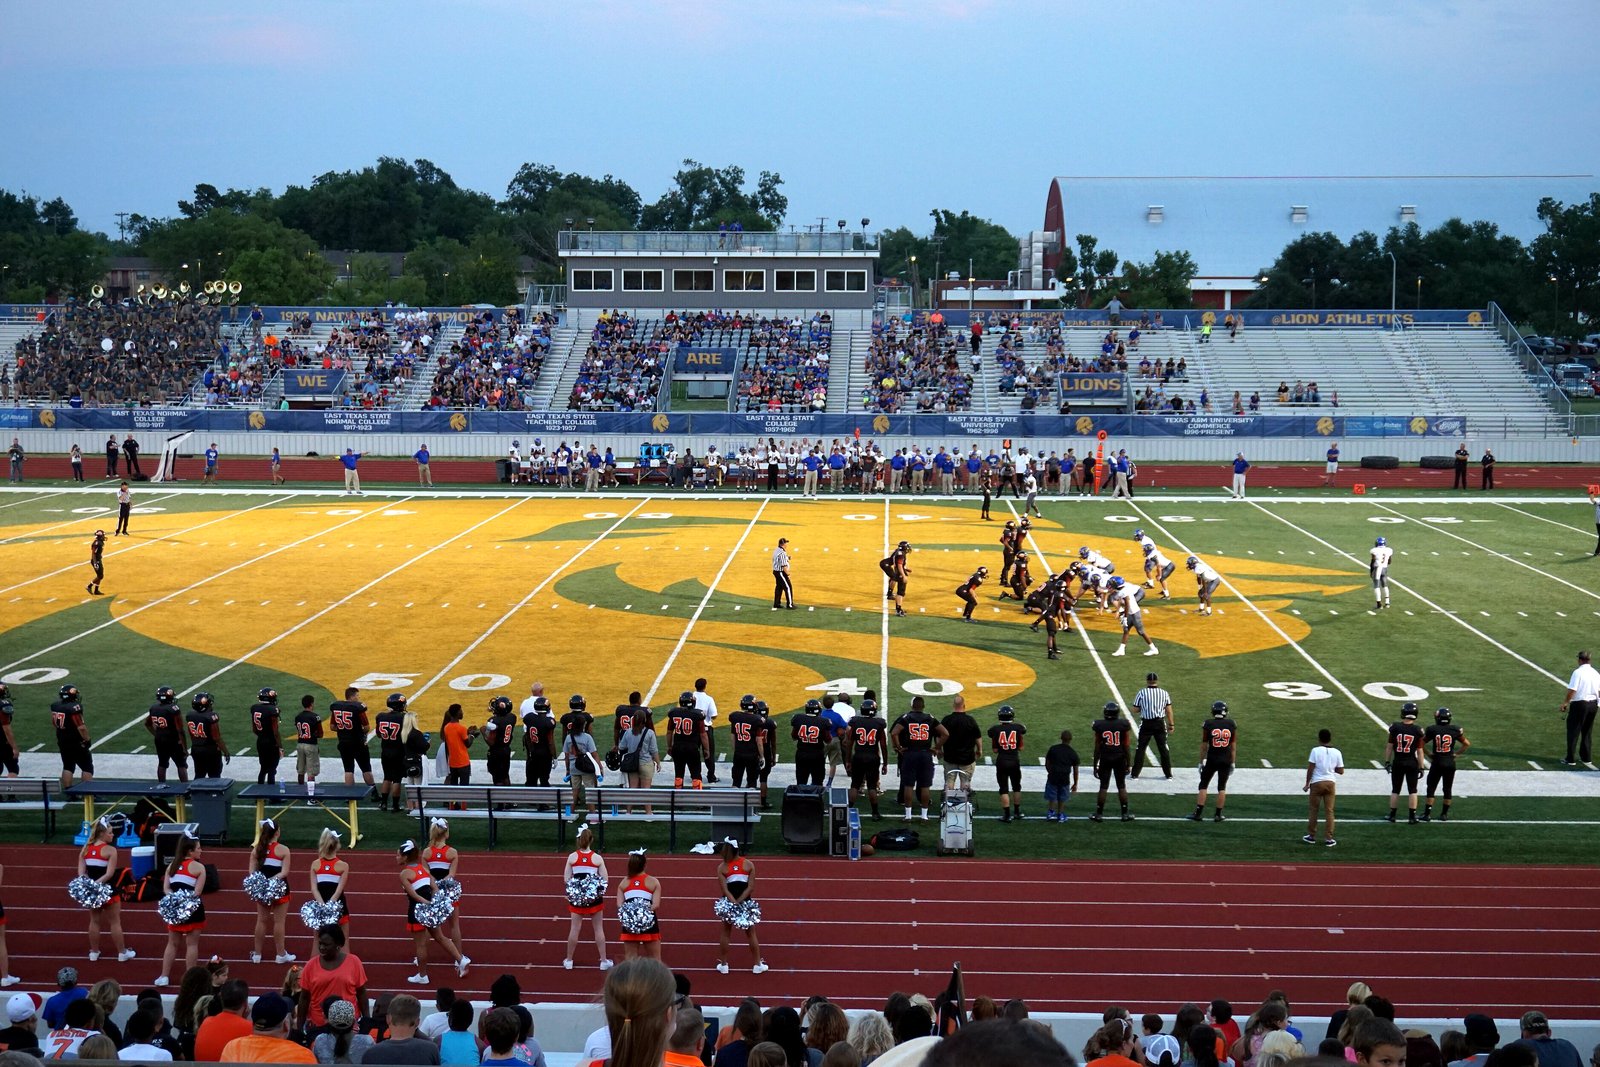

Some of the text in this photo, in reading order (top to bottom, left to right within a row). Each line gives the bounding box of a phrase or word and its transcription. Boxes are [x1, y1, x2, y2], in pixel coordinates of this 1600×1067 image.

[686, 352, 722, 365] ARE
[297, 375, 328, 387] WE
[1062, 378, 1122, 391] LIONS
[253, 711, 263, 731] 5
[333, 710, 353, 730] 55
[673, 717, 693, 735] 70
[378, 721, 401, 740] 57
[503, 724, 513, 744] 9
[529, 726, 539, 744] 6
[735, 722, 752, 741] 15
[798, 724, 820, 744] 42
[855, 727, 877, 746] 34
[908, 722, 930, 741] 56
[998, 730, 1018, 750] 44
[1102, 731, 1121, 746] 31
[1211, 728, 1232, 748] 29
[1396, 733, 1415, 753] 17
[1434, 734, 1452, 753] 12
[53, 1038, 74, 1060] 7
